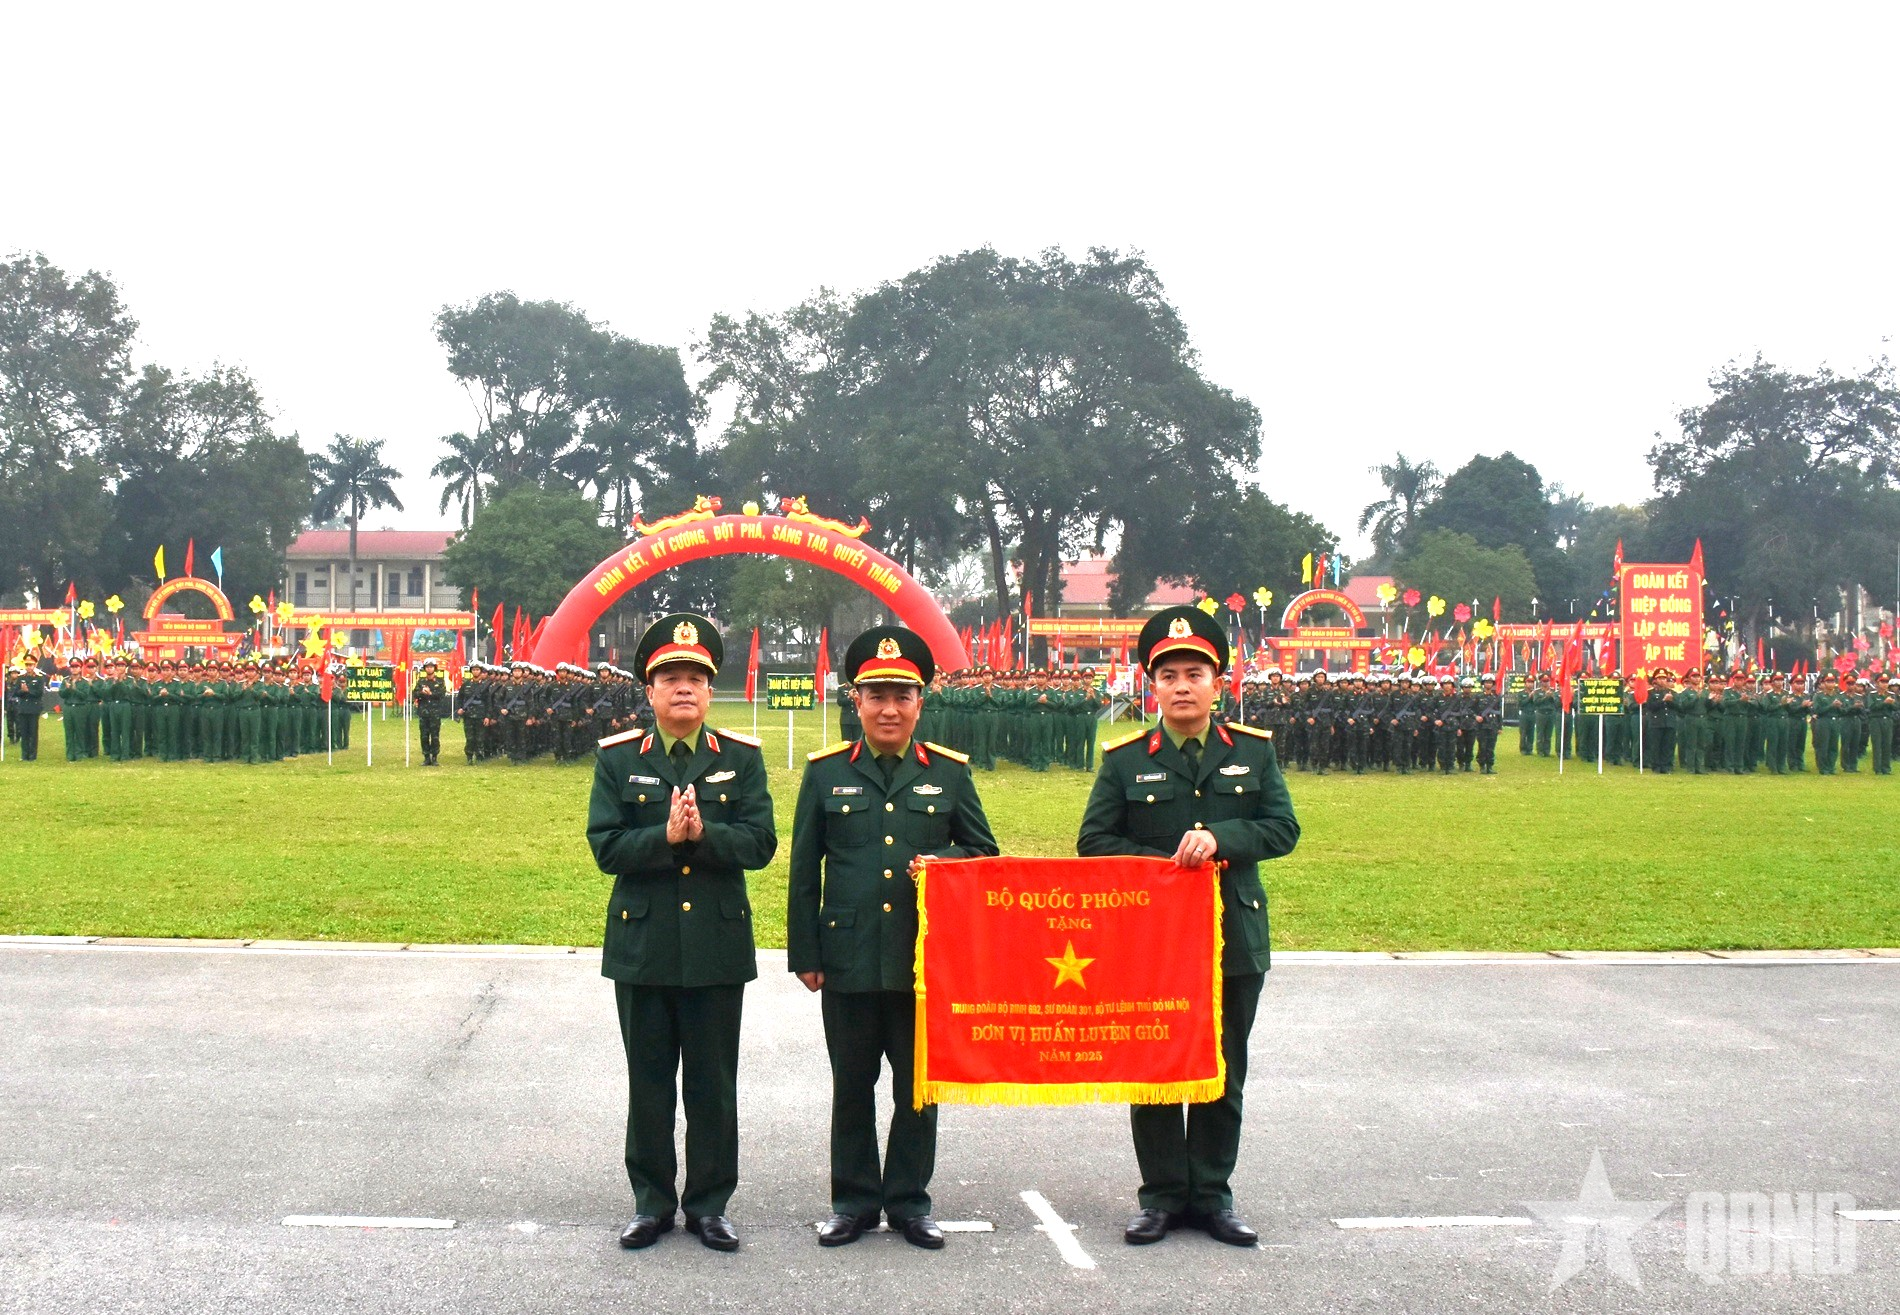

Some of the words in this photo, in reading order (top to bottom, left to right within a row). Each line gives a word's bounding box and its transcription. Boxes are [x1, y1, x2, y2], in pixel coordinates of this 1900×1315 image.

[594, 567, 625, 596] ĐOÀN
[623, 551, 649, 573] KẾT,
[650, 537, 667, 558] KỶ
[668, 528, 709, 552] CƯƠNG,
[713, 522, 734, 542] ĐỘT
[740, 522, 765, 541] PHÁ,
[772, 524, 802, 545] SÁNG
[807, 532, 828, 555] TẠO,
[833, 543, 868, 569] QUYẾT
[867, 562, 902, 594] THẮNG
[1633, 572, 1664, 588] ĐOÀN
[1668, 570, 1688, 588] KẾT
[1631, 595, 1658, 616] HIỆP
[1634, 619, 1656, 640] LẬP
[1658, 619, 1690, 636] CÔNG
[1664, 640, 1686, 660] THỂ
[986, 886, 1014, 910] BỘ
[1020, 886, 1075, 911] QUỐC
[1080, 888, 1150, 909] PHÒNG
[1046, 916, 1092, 932] TẶNG
[952, 1003, 975, 1014] TRUNG
[976, 1000, 996, 1014] ĐOÀN
[998, 1001, 1008, 1017] BỘ
[1010, 1003, 1027, 1014] BINH
[1028, 1004, 1044, 1016] 692,
[1044, 1003, 1055, 1014] SƯ
[1056, 1002, 1078, 1015] ĐOÀN
[1078, 1004, 1094, 1016] 301,
[1095, 1002, 1104, 1017] BỘ
[1105, 1002, 1115, 1013] TƯ
[1116, 1000, 1134, 1015] LỆNH
[1136, 997, 1152, 1012] THỦ
[1152, 998, 1164, 1012] ĐÔ
[1164, 998, 1176, 1011] HÀ
[1176, 997, 1190, 1013] NỘI
[972, 1024, 1004, 1042] ĐƠN
[1008, 1026, 1026, 1046] VỊ
[1030, 1020, 1076, 1042] HUẤN
[1080, 1020, 1131, 1044] LUYỆN
[1135, 1018, 1170, 1040] GIỎI
[1039, 1048, 1070, 1062] NĂM
[1074, 1050, 1103, 1062] 2025
